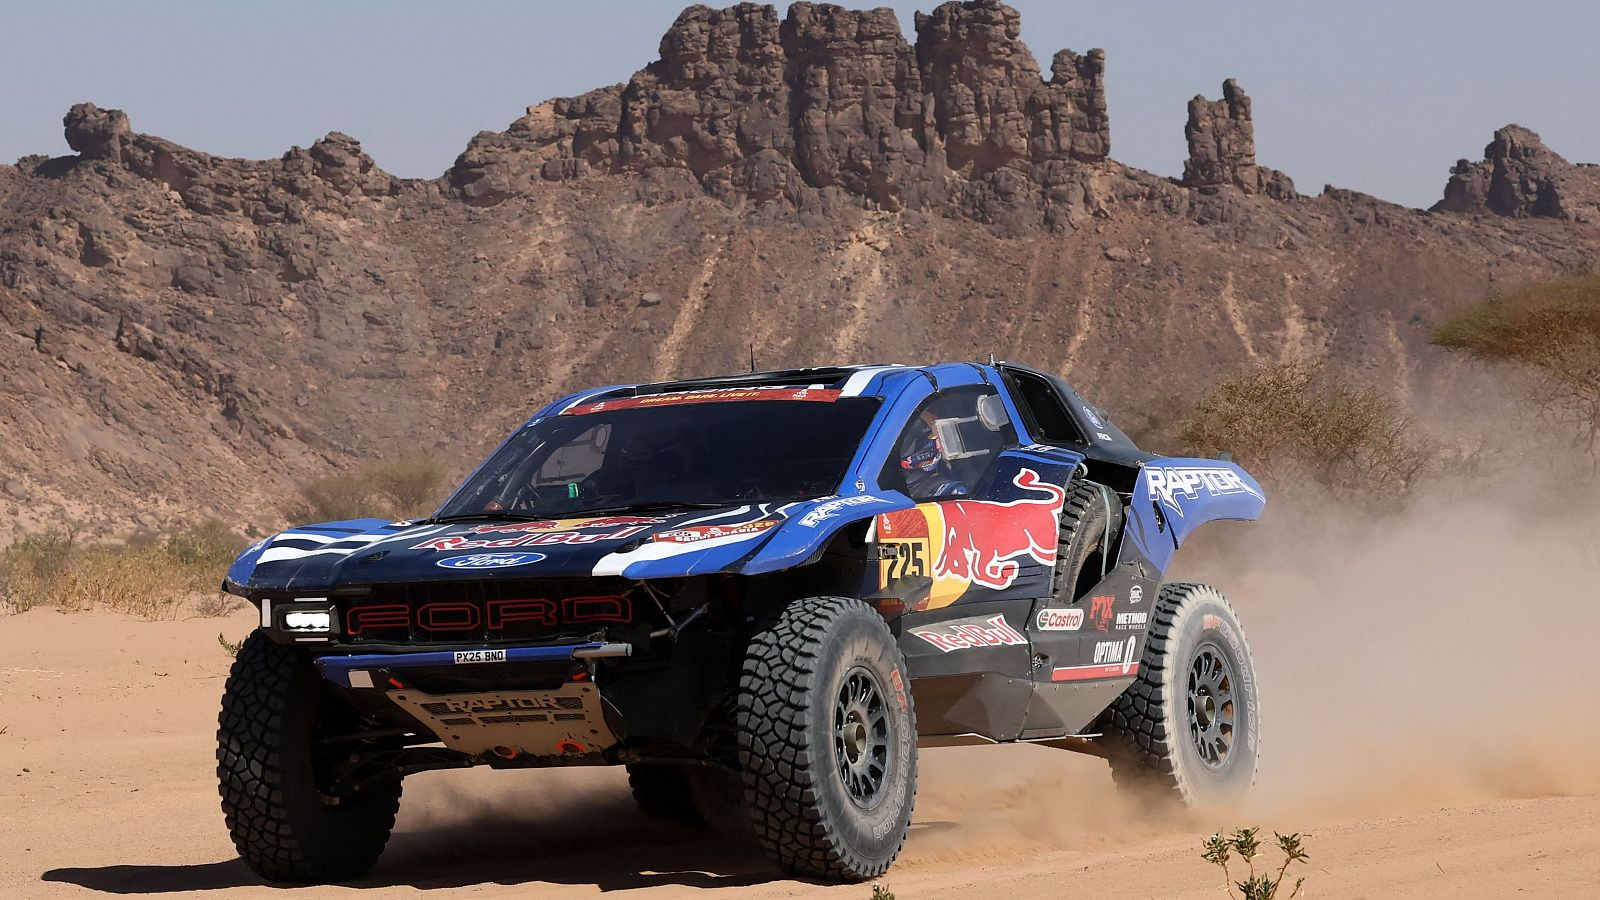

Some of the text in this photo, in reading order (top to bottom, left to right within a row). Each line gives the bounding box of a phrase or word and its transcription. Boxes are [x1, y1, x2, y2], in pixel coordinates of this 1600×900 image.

[1144, 466, 1265, 517] RAPTOR
[798, 495, 895, 528] RAPTOR
[455, 552, 528, 568] Ford
[346, 595, 633, 635] FORD
[1048, 612, 1082, 627] Castrol
[1116, 612, 1147, 624] METHOD
[456, 651, 481, 662] PX25
[1094, 640, 1123, 664] OPTIMA
[449, 697, 560, 713] RAPTOR
